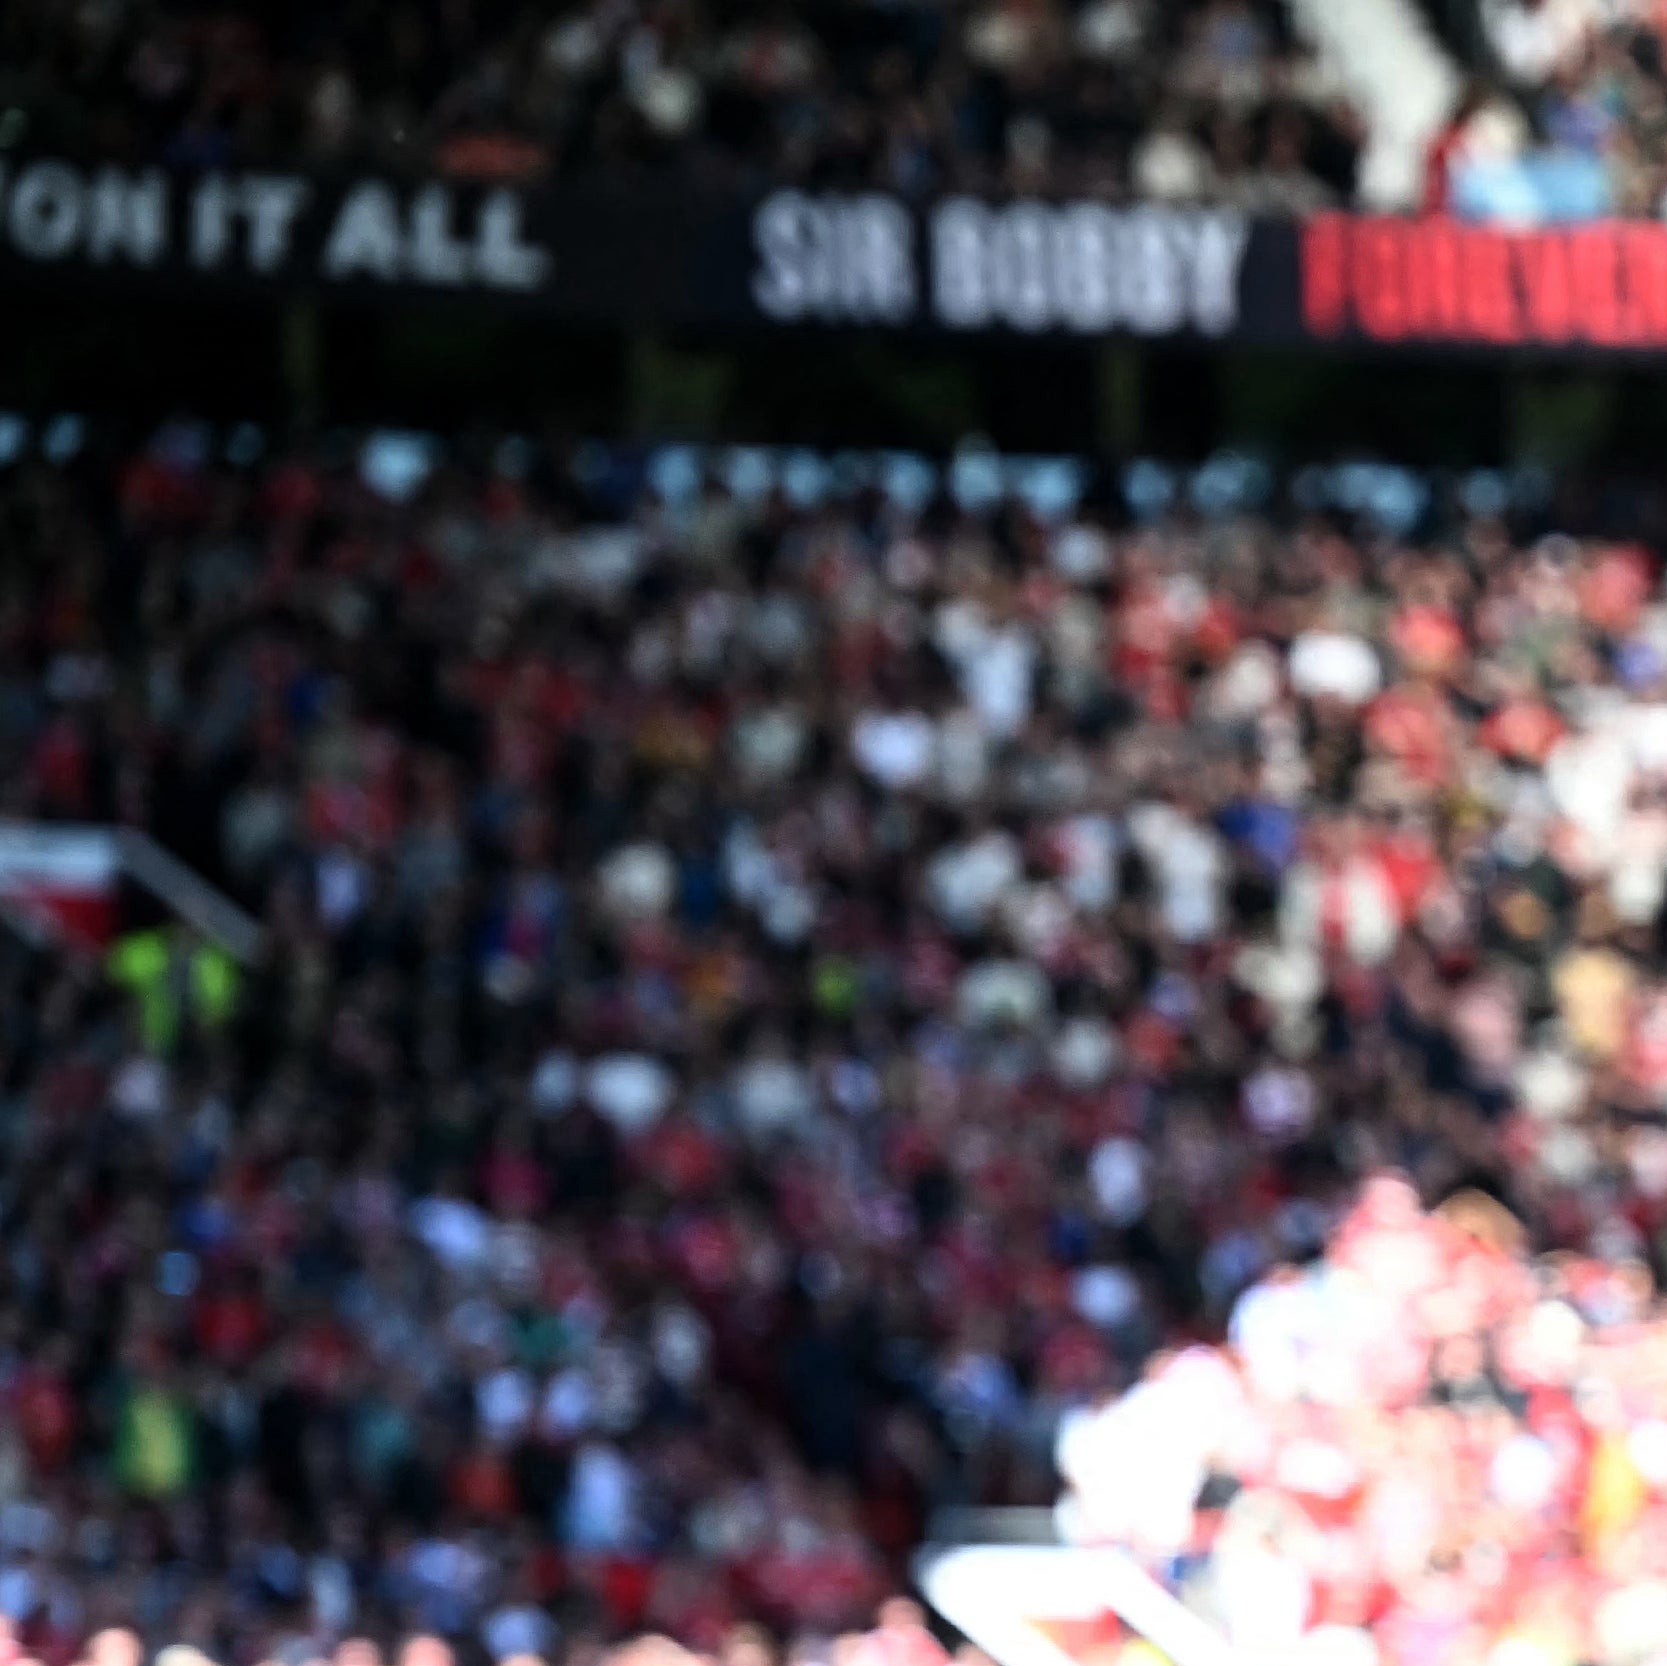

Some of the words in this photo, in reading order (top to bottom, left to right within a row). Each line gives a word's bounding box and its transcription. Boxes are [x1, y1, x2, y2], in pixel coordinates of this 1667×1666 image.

[6, 158, 168, 266] ON
[192, 168, 303, 274] IT
[322, 178, 556, 291] ALL
